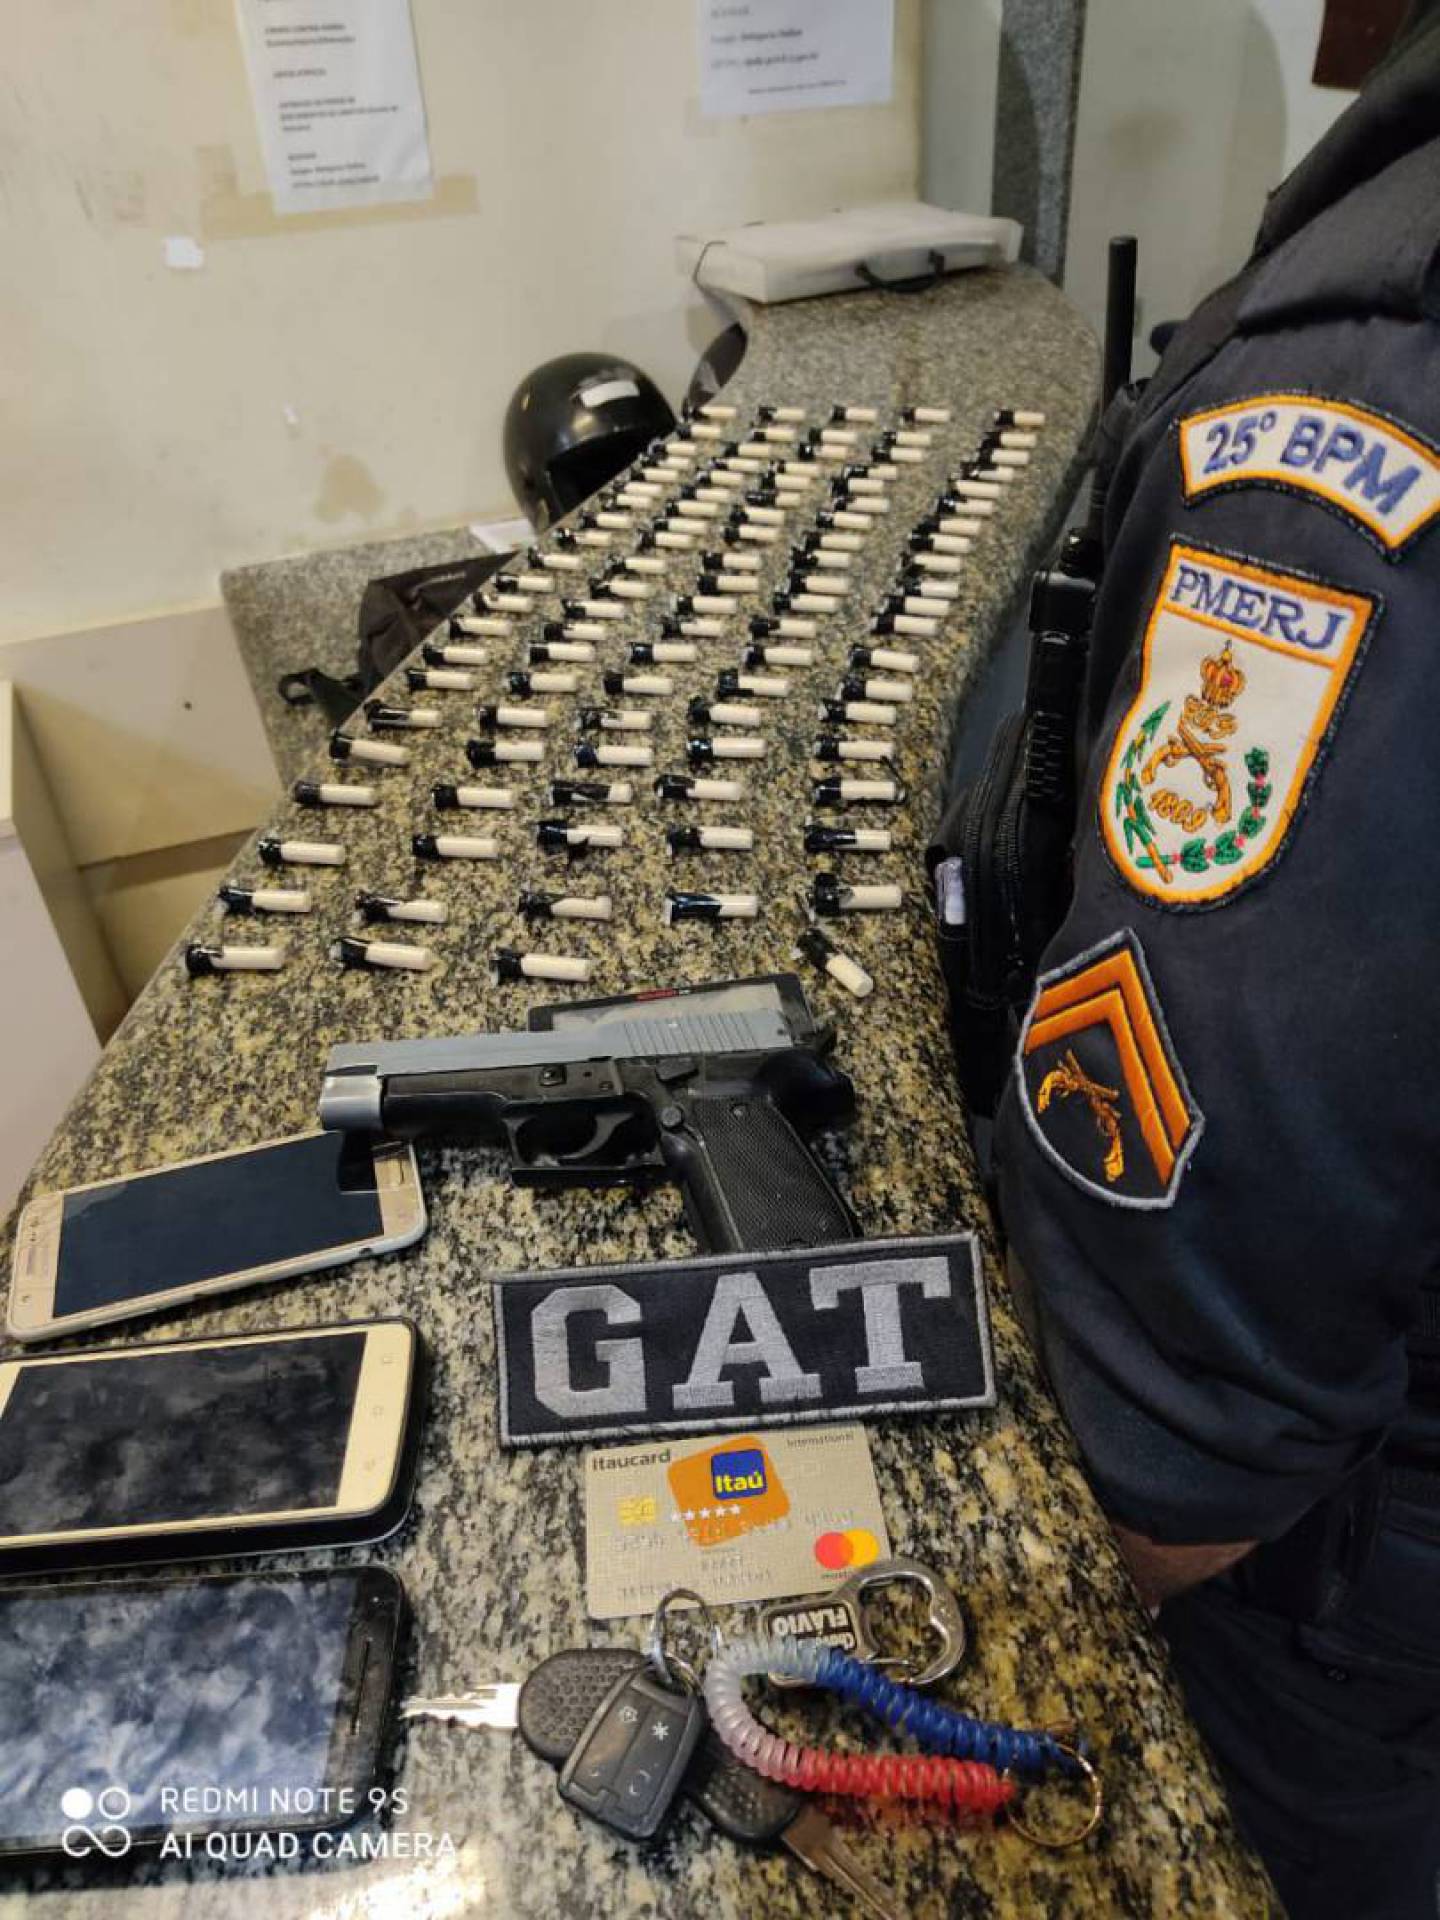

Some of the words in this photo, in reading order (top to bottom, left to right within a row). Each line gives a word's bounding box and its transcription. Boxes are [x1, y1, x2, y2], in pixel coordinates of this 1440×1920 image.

[1279, 415, 1421, 515] BPM
[1171, 564, 1346, 649] PMERJ
[531, 1256, 951, 1418] GAT
[592, 1448, 671, 1471] Itaucard
[715, 1470, 763, 1493] Itaú
[771, 1606, 849, 1637] FLÁVIO
